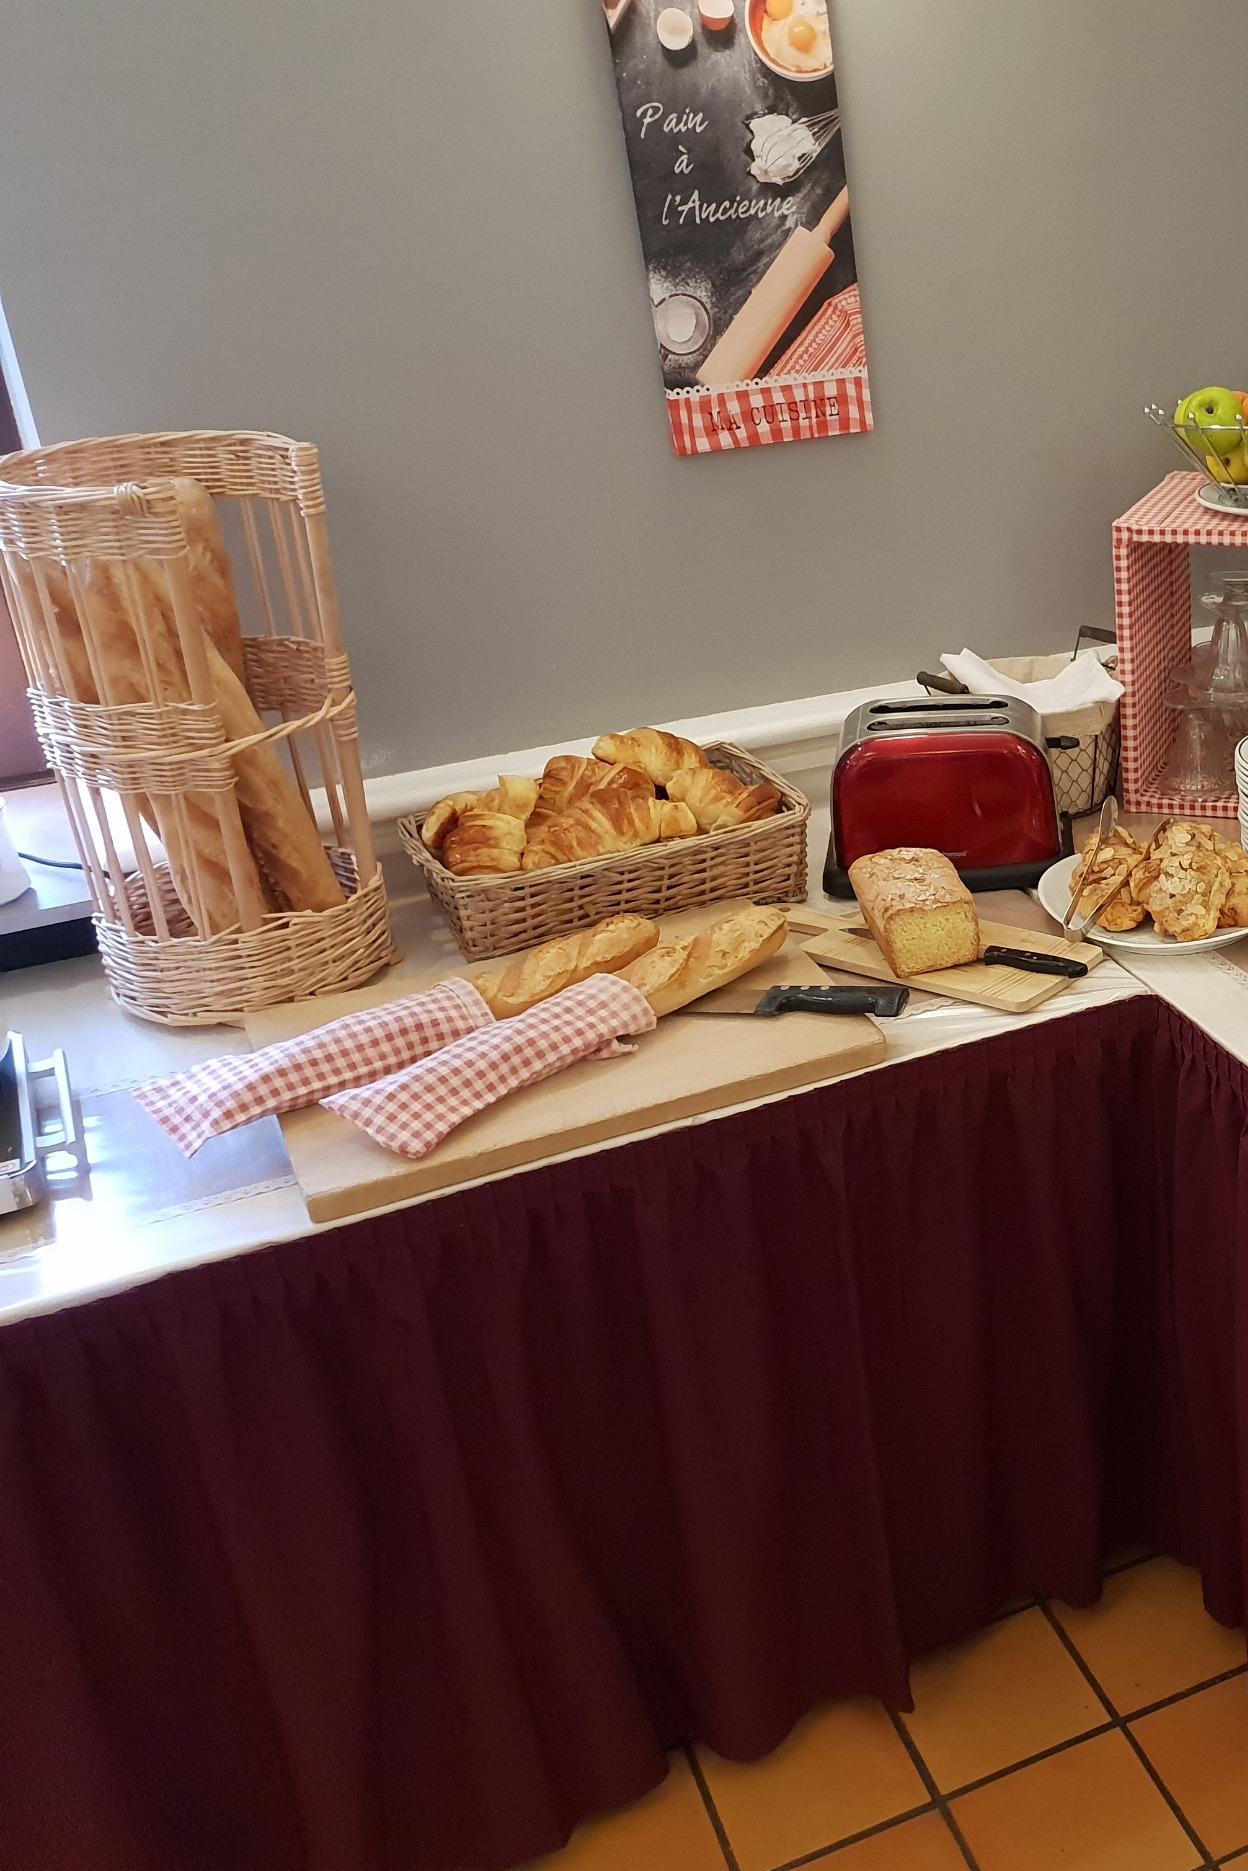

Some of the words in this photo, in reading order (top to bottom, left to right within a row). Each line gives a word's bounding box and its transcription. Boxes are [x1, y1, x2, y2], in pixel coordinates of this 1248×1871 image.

[636, 102, 708, 138] Pain
[674, 146, 692, 175] à
[662, 188, 797, 225] l'Ancienne
[708, 408, 741, 432] MA
[750, 395, 840, 427] CUISINE
